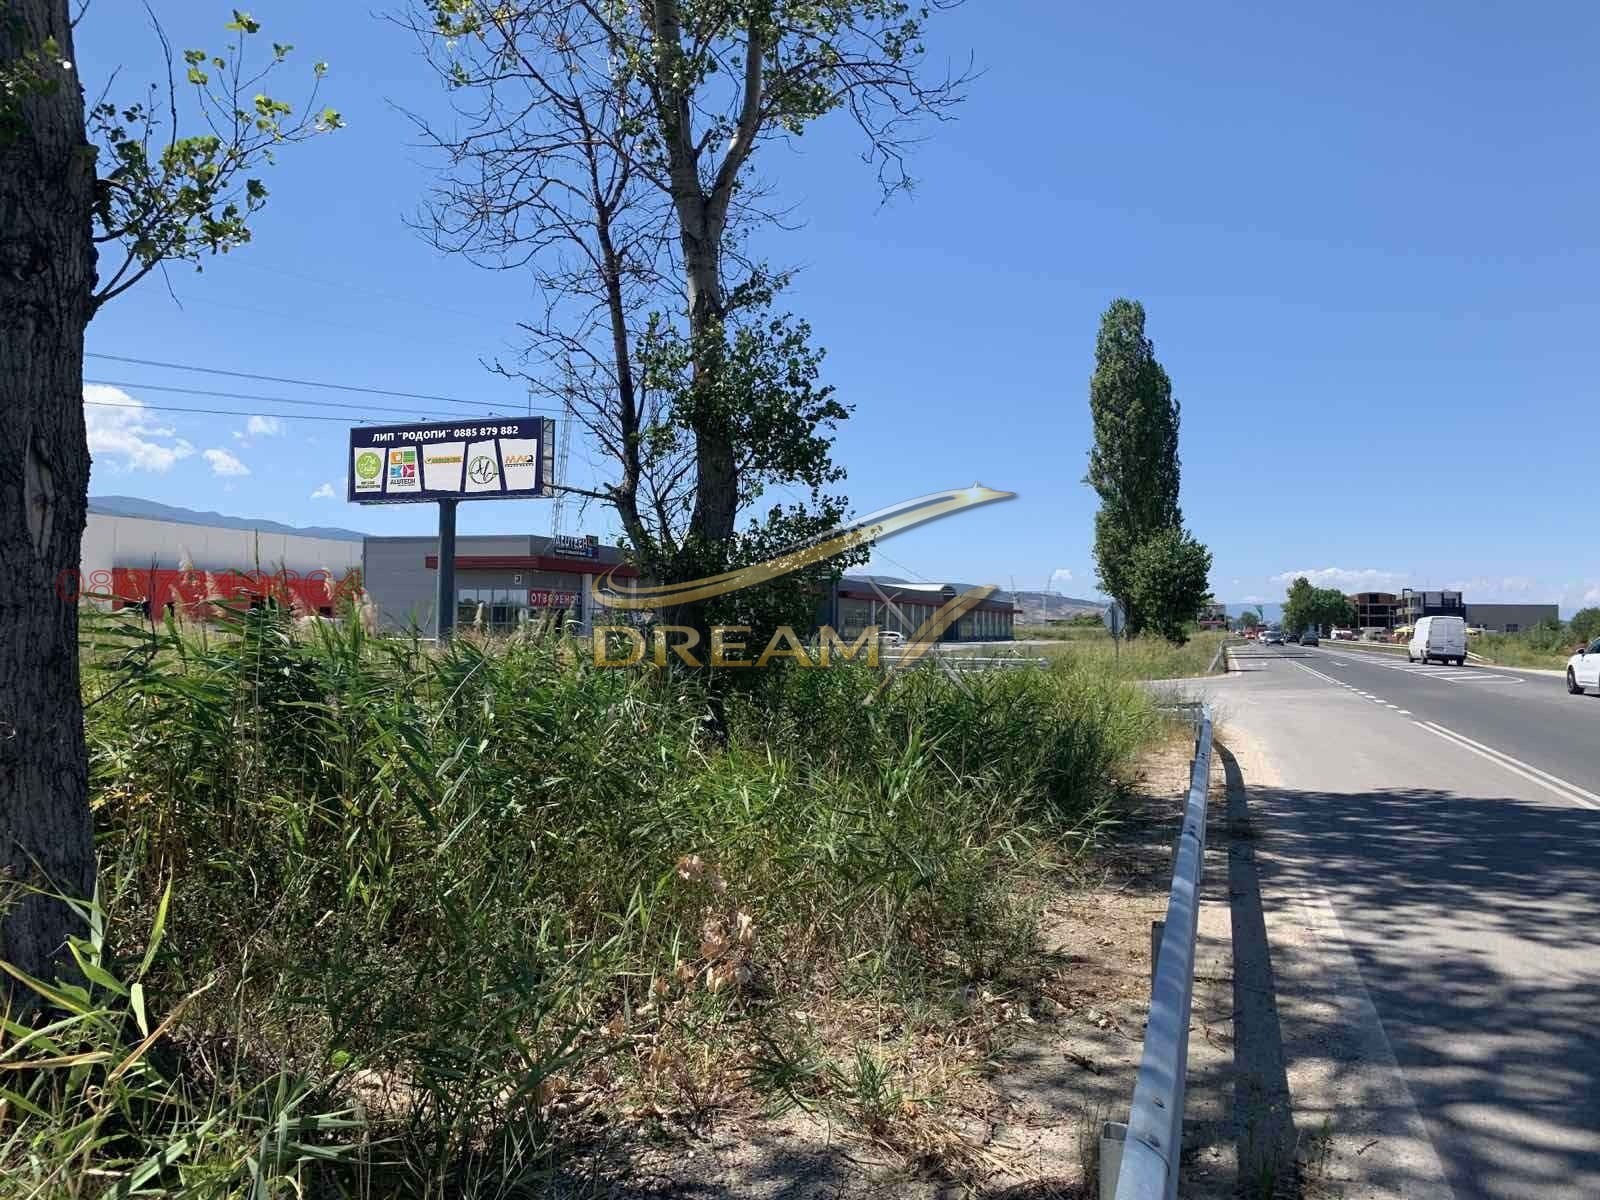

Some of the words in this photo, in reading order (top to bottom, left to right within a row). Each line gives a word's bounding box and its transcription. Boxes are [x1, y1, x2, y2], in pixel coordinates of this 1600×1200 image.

[372, 433, 394, 442] ЛИП
[454, 428, 477, 438] 0885
[480, 427, 498, 436] 879
[500, 426, 519, 434] 882
